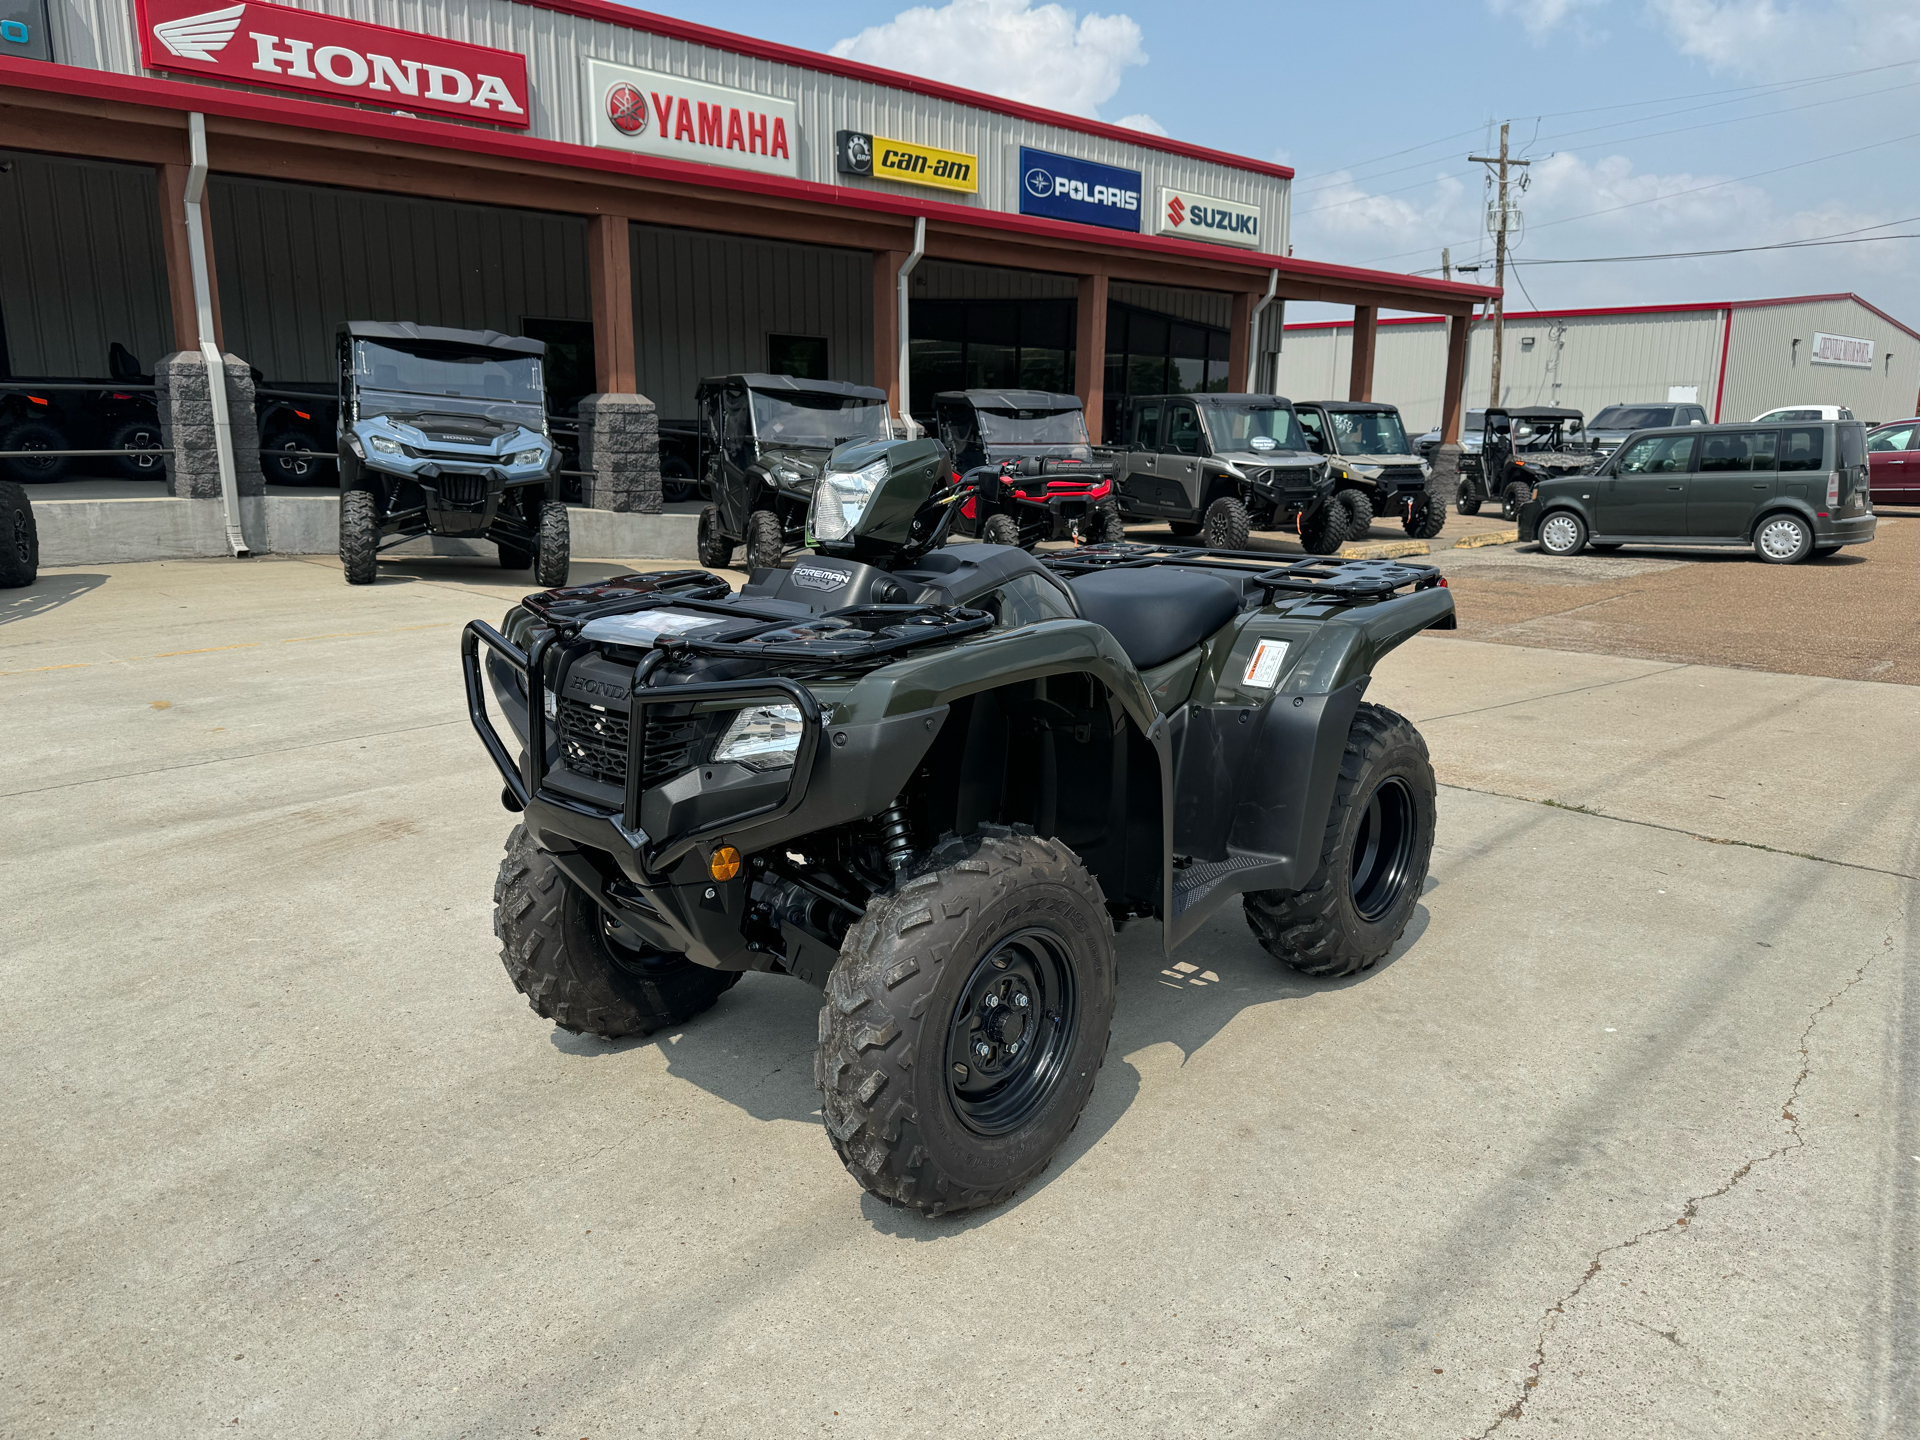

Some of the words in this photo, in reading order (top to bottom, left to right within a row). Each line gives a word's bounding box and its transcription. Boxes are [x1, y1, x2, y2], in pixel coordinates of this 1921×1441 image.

[249, 32, 524, 114] HONDA
[651, 92, 789, 159] YAMAHA
[881, 149, 970, 181] can-am
[1055, 176, 1138, 211] POLARIS
[1190, 205, 1257, 236] SUZUKI
[792, 568, 850, 584] FOREMAN
[974, 896, 1088, 960] MAXXIS
